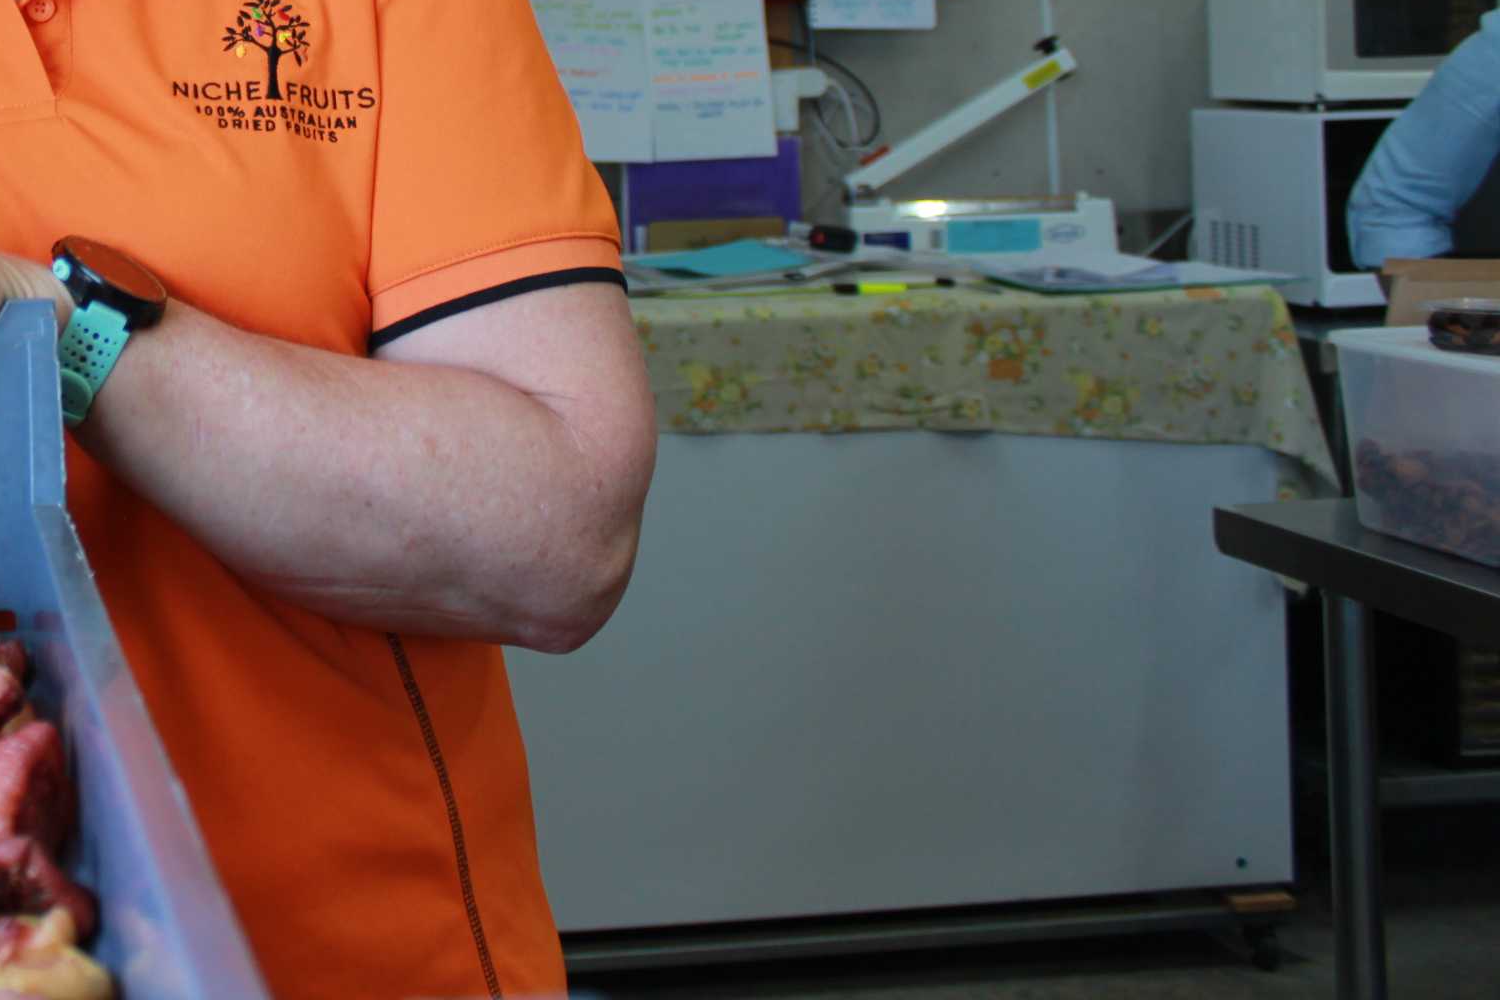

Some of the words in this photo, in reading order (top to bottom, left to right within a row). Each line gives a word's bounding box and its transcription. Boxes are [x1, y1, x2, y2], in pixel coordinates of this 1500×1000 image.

[172, 81, 261, 101] NICHE
[285, 83, 376, 109] FRUITS
[195, 104, 246, 119] 100%
[253, 104, 358, 130] AUSTRALIAN
[217, 117, 277, 132] DRIED
[285, 121, 339, 143] FRUITS
